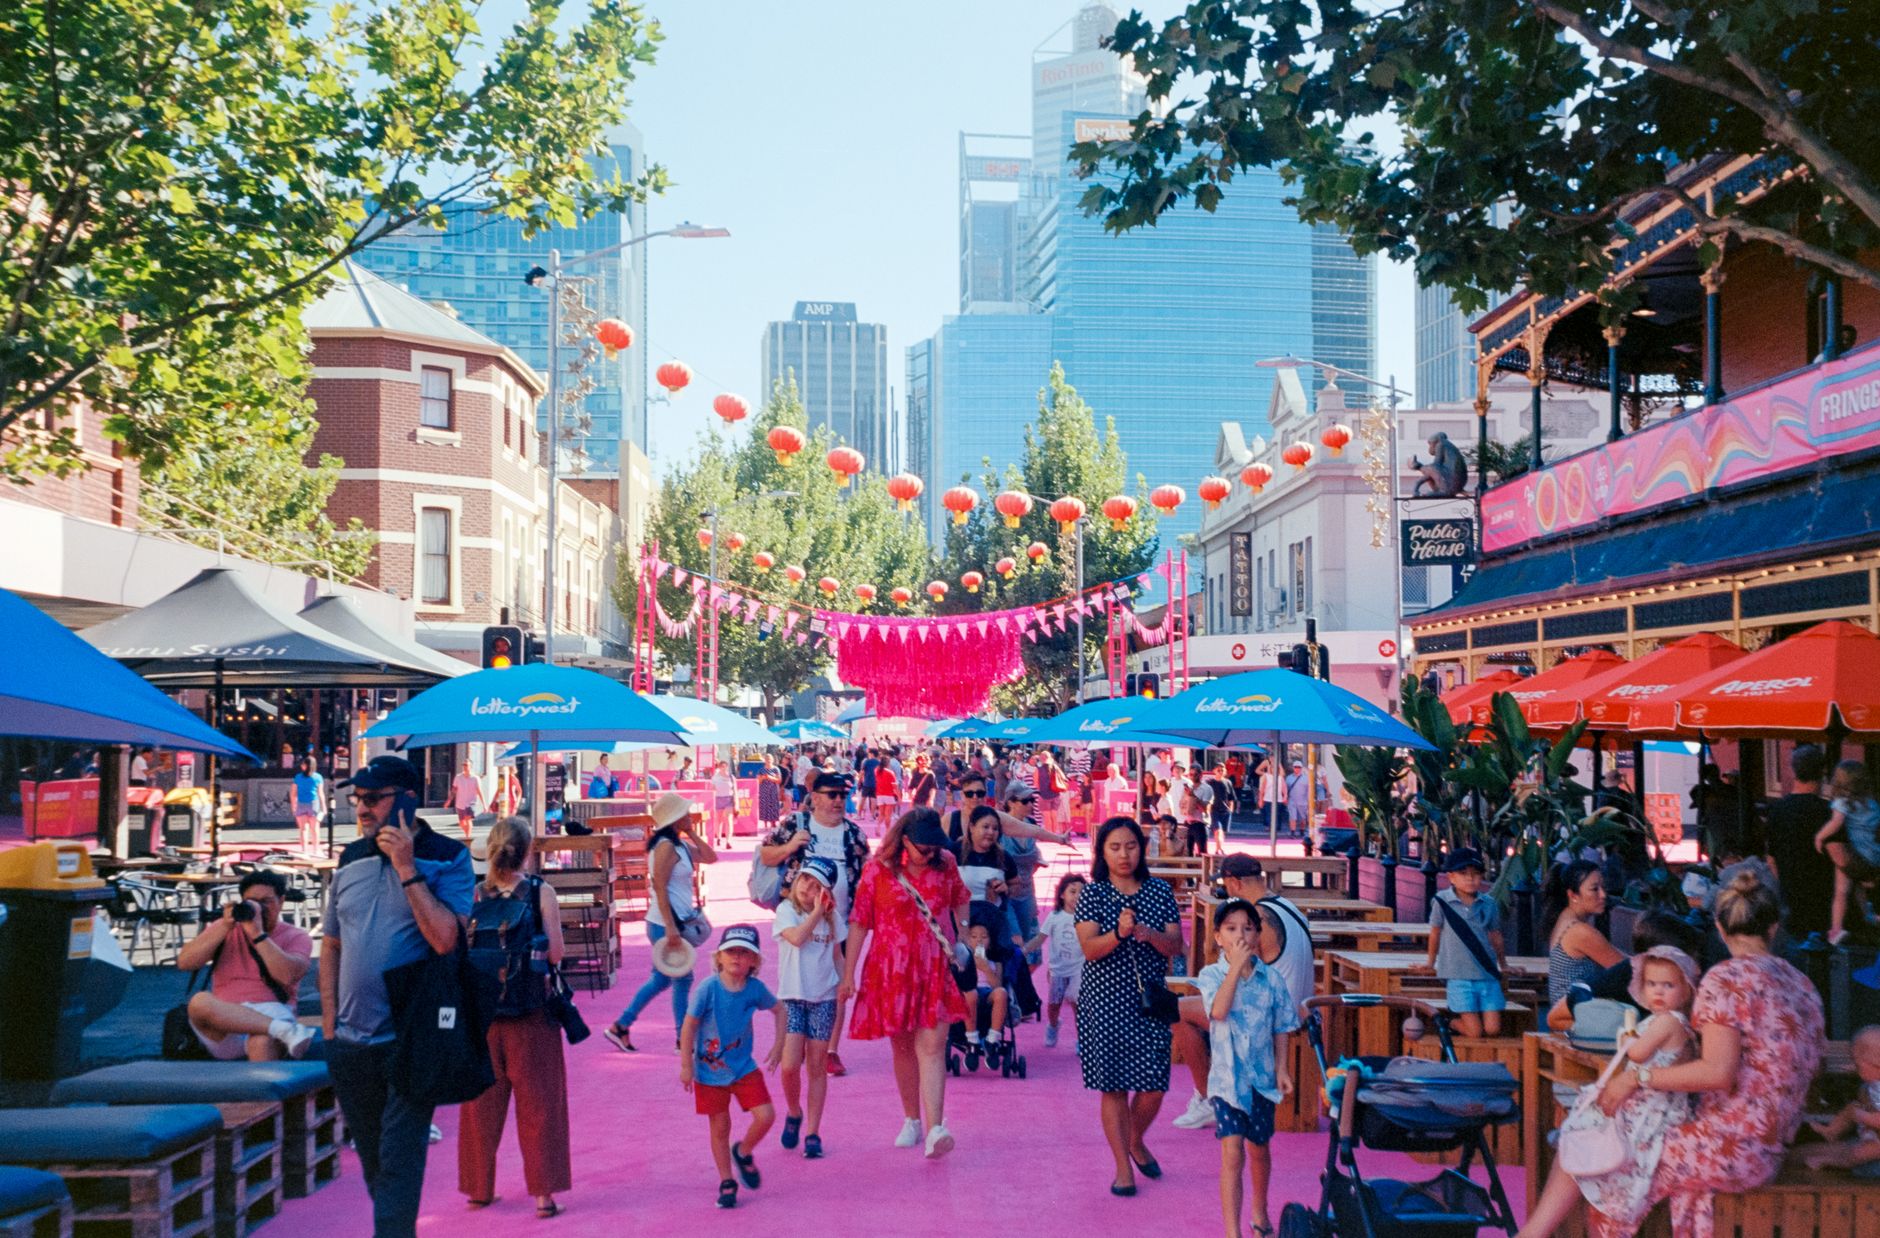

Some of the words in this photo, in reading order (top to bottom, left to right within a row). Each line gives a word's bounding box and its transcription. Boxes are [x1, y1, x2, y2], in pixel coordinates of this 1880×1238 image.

[1081, 124, 1135, 139] bankw
[804, 303, 833, 315] AMP
[1820, 380, 1880, 424] FRINGE
[1409, 523, 1461, 541] Public
[1410, 541, 1465, 560] House
[1236, 534, 1249, 611] TATTOO
[183, 643, 290, 656] Sushi
[1607, 684, 1675, 697] APER
[1709, 676, 1814, 696] APEROL
[471, 696, 582, 717] lotterywest
[1195, 697, 1283, 715] lotterywest
[440, 1013, 452, 1023] W
